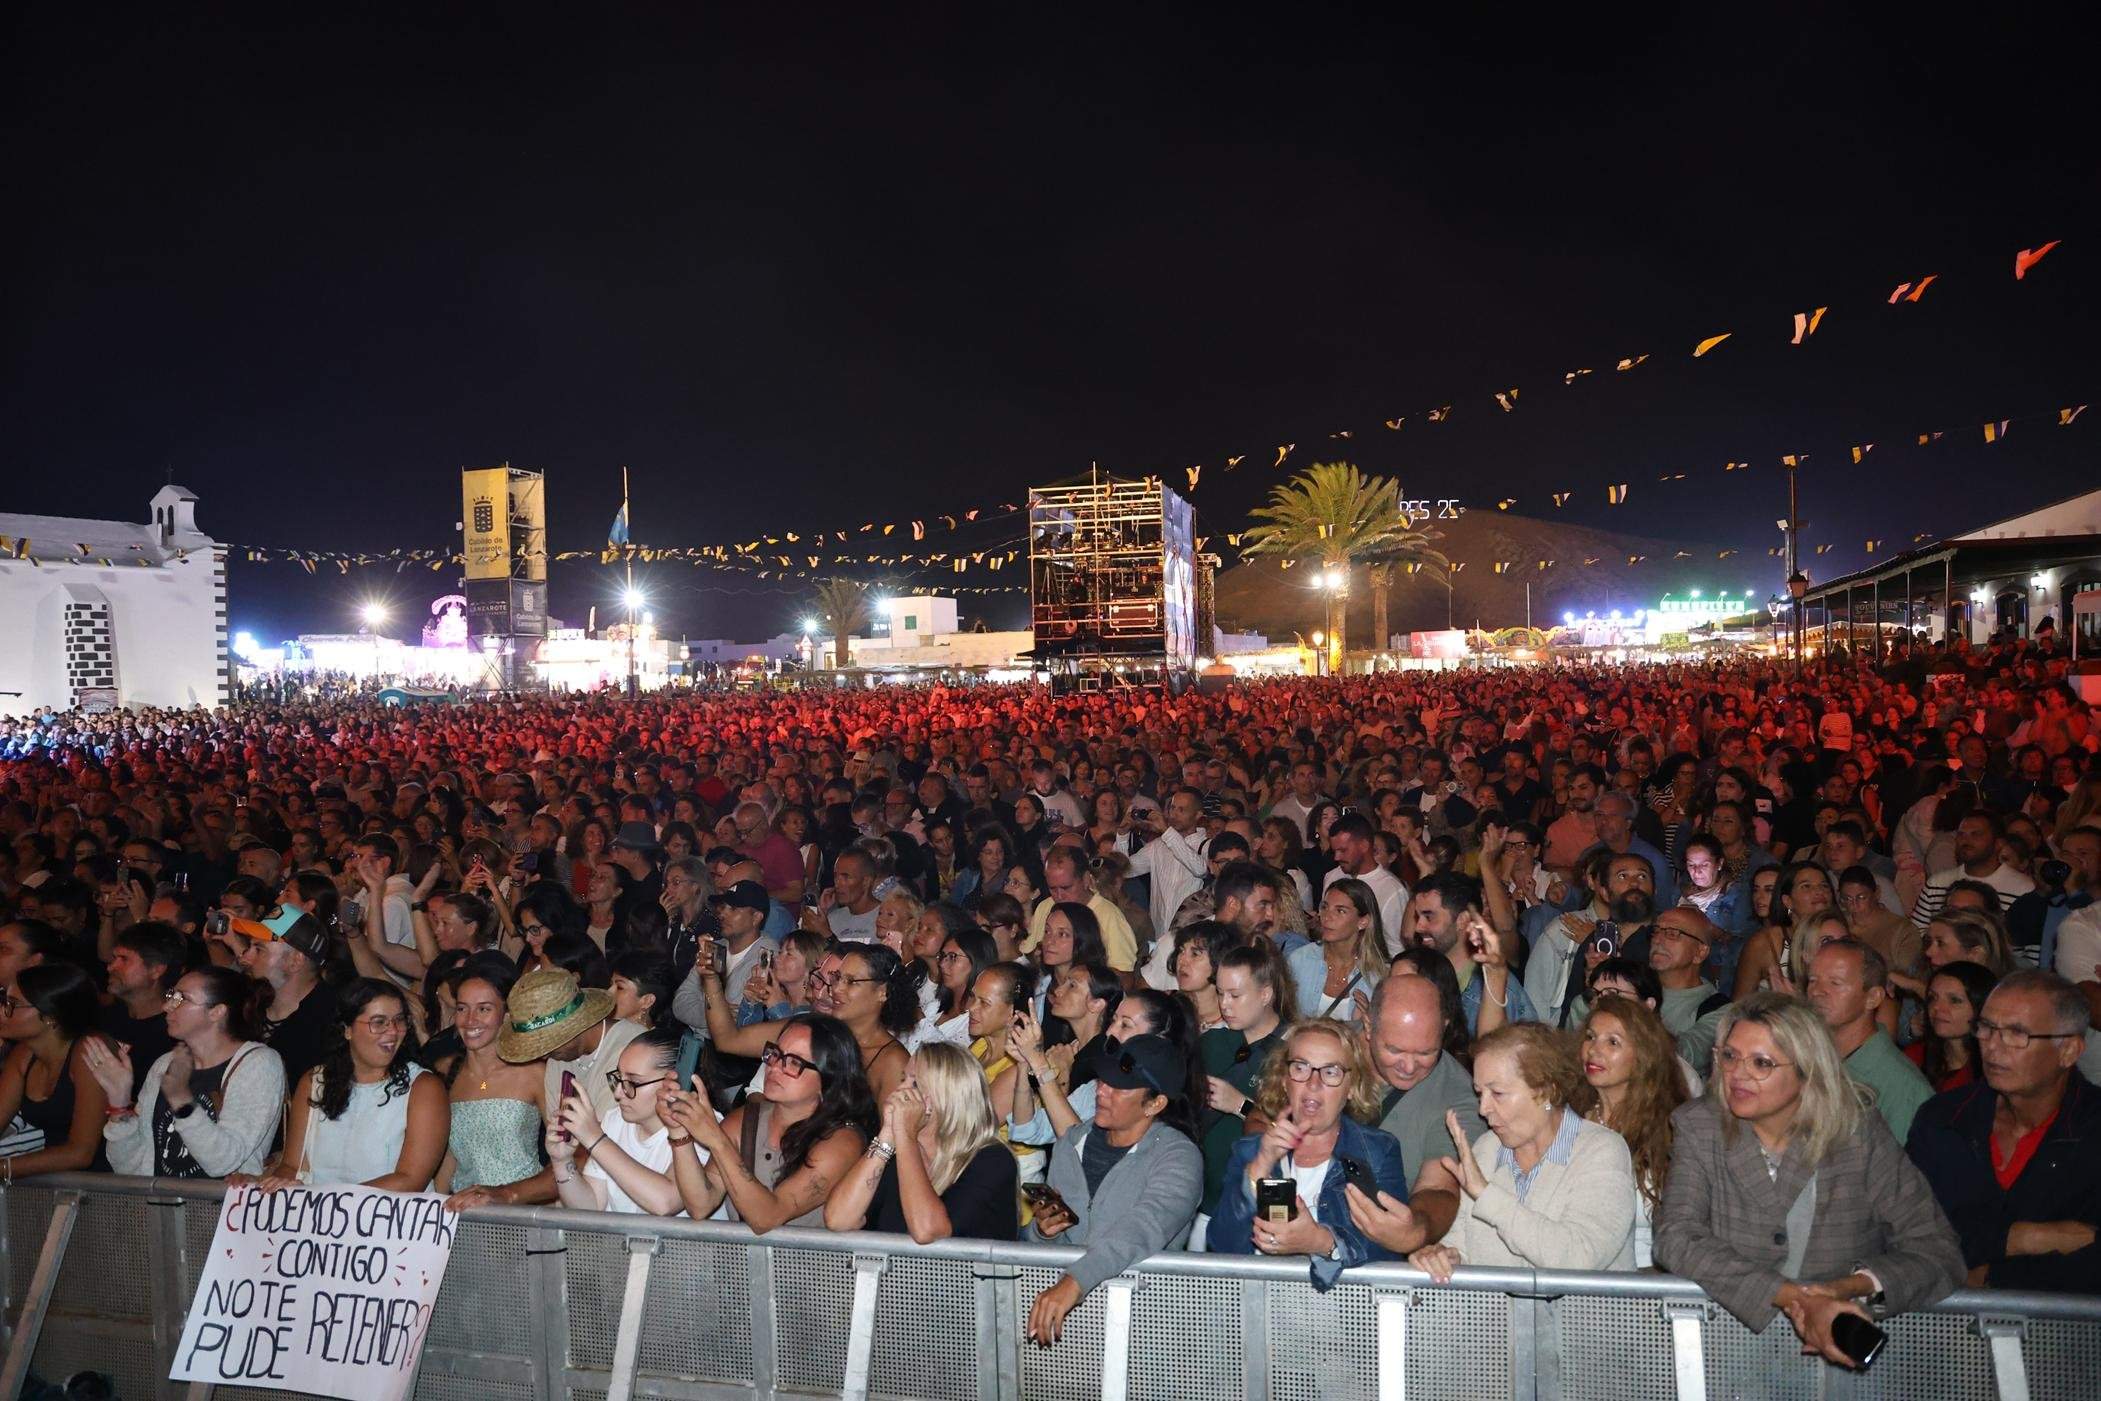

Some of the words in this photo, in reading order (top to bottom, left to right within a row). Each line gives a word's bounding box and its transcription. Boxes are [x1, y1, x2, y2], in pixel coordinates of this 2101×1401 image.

[1437, 500, 1459, 519] 25
[277, 1239, 388, 1285] CONTIGO
[203, 1278, 255, 1319] NO
[260, 1280, 297, 1322] TE
[185, 1322, 293, 1380] PUDE
[306, 1290, 431, 1371] RETENER?
